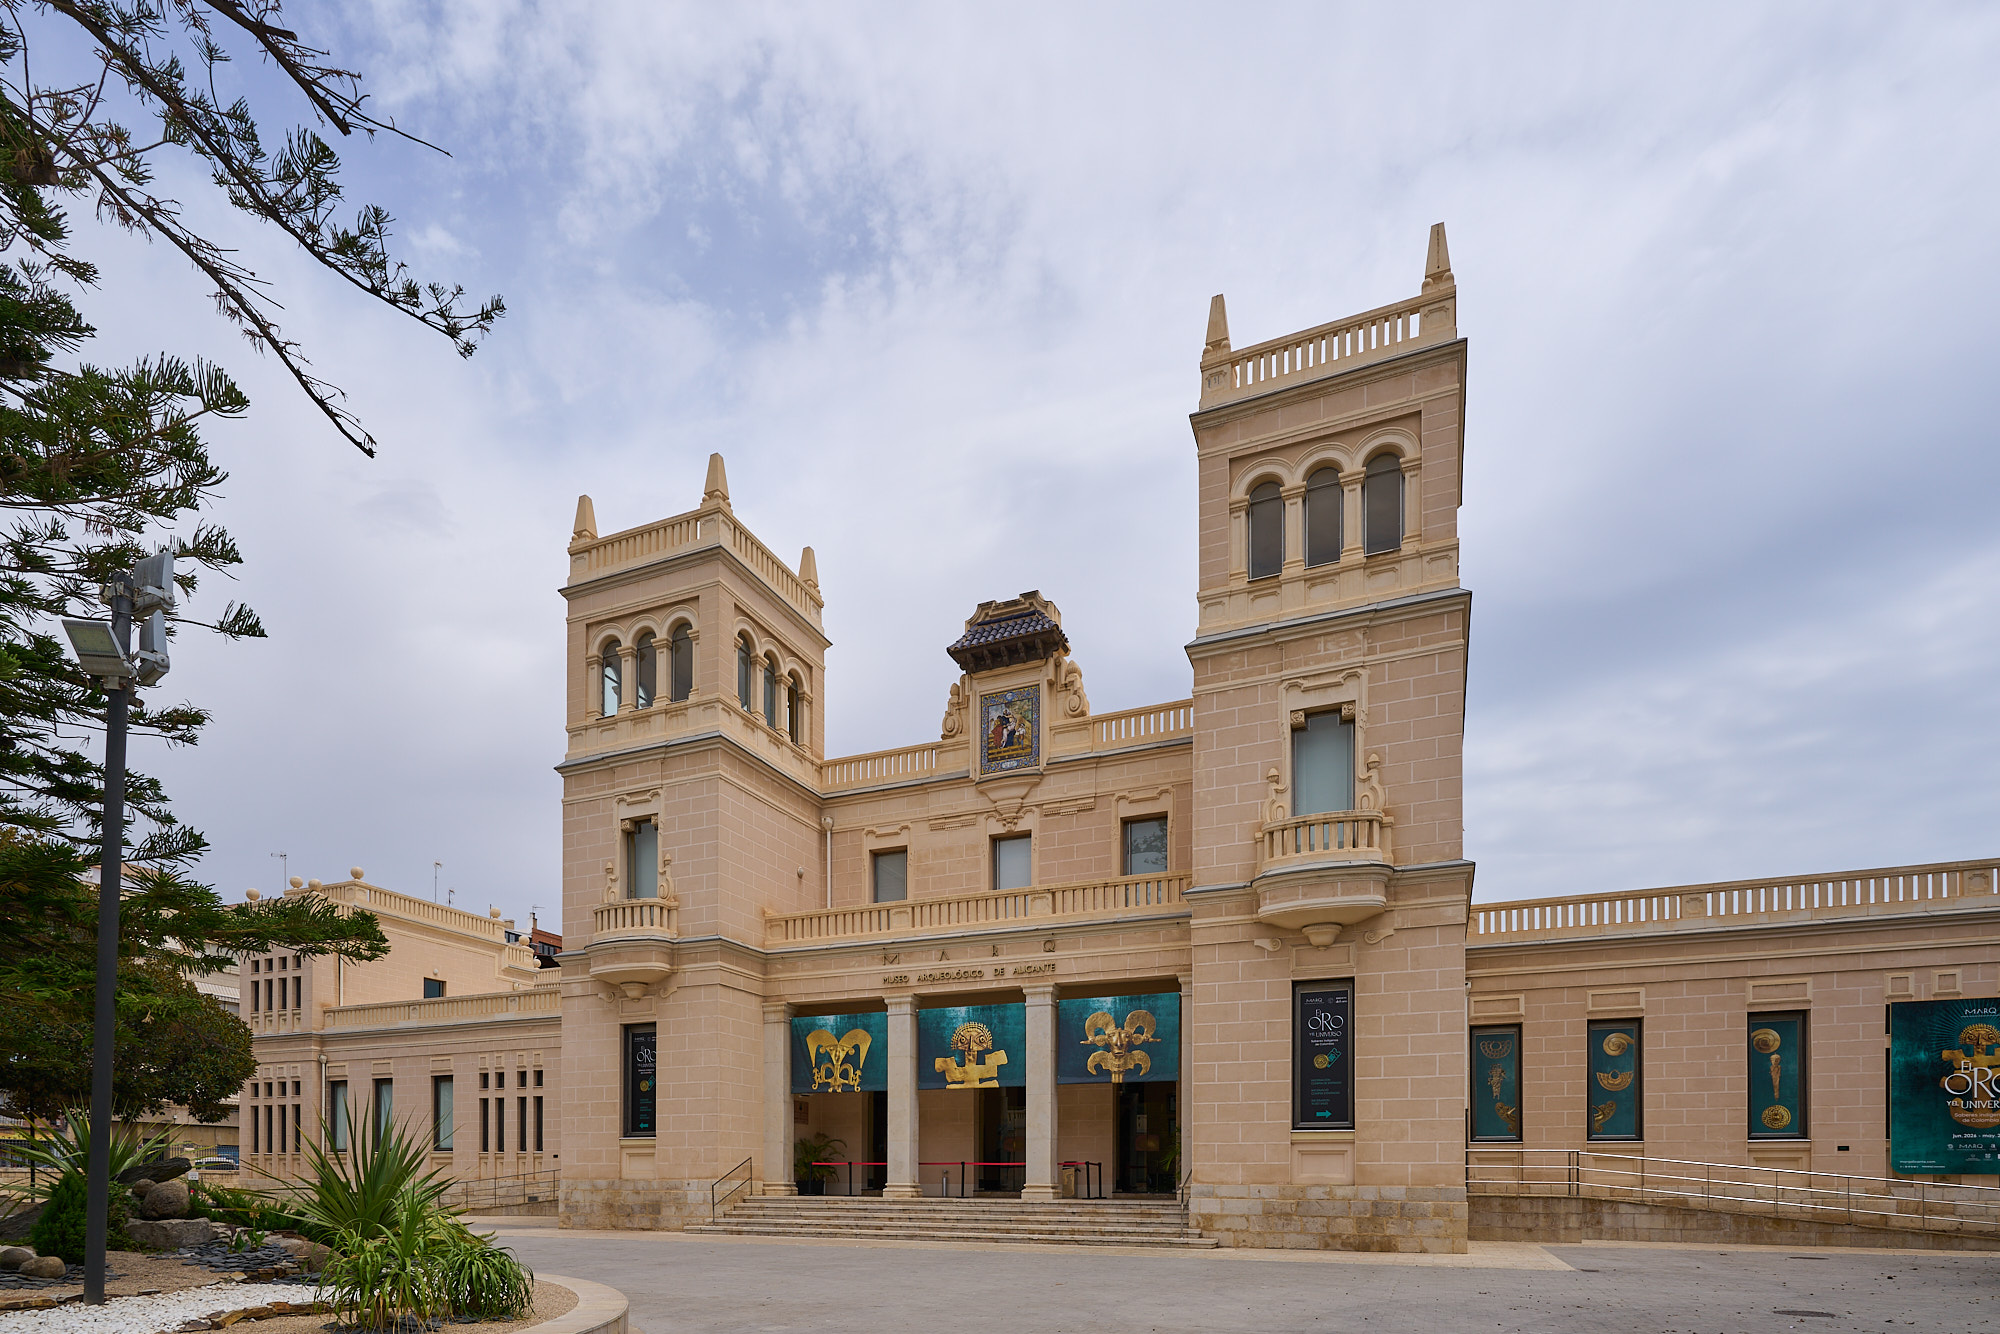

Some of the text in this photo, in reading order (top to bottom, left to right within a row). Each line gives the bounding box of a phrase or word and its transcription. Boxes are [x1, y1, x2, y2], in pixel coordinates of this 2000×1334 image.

[882, 962, 1056, 985] MUSEO ARQUEOLÓGICO DE ALICANTE
[1964, 1007, 1997, 1015] MARQ
[1308, 1012, 1344, 1031] ORO
[1961, 1060, 1975, 1074] EL
